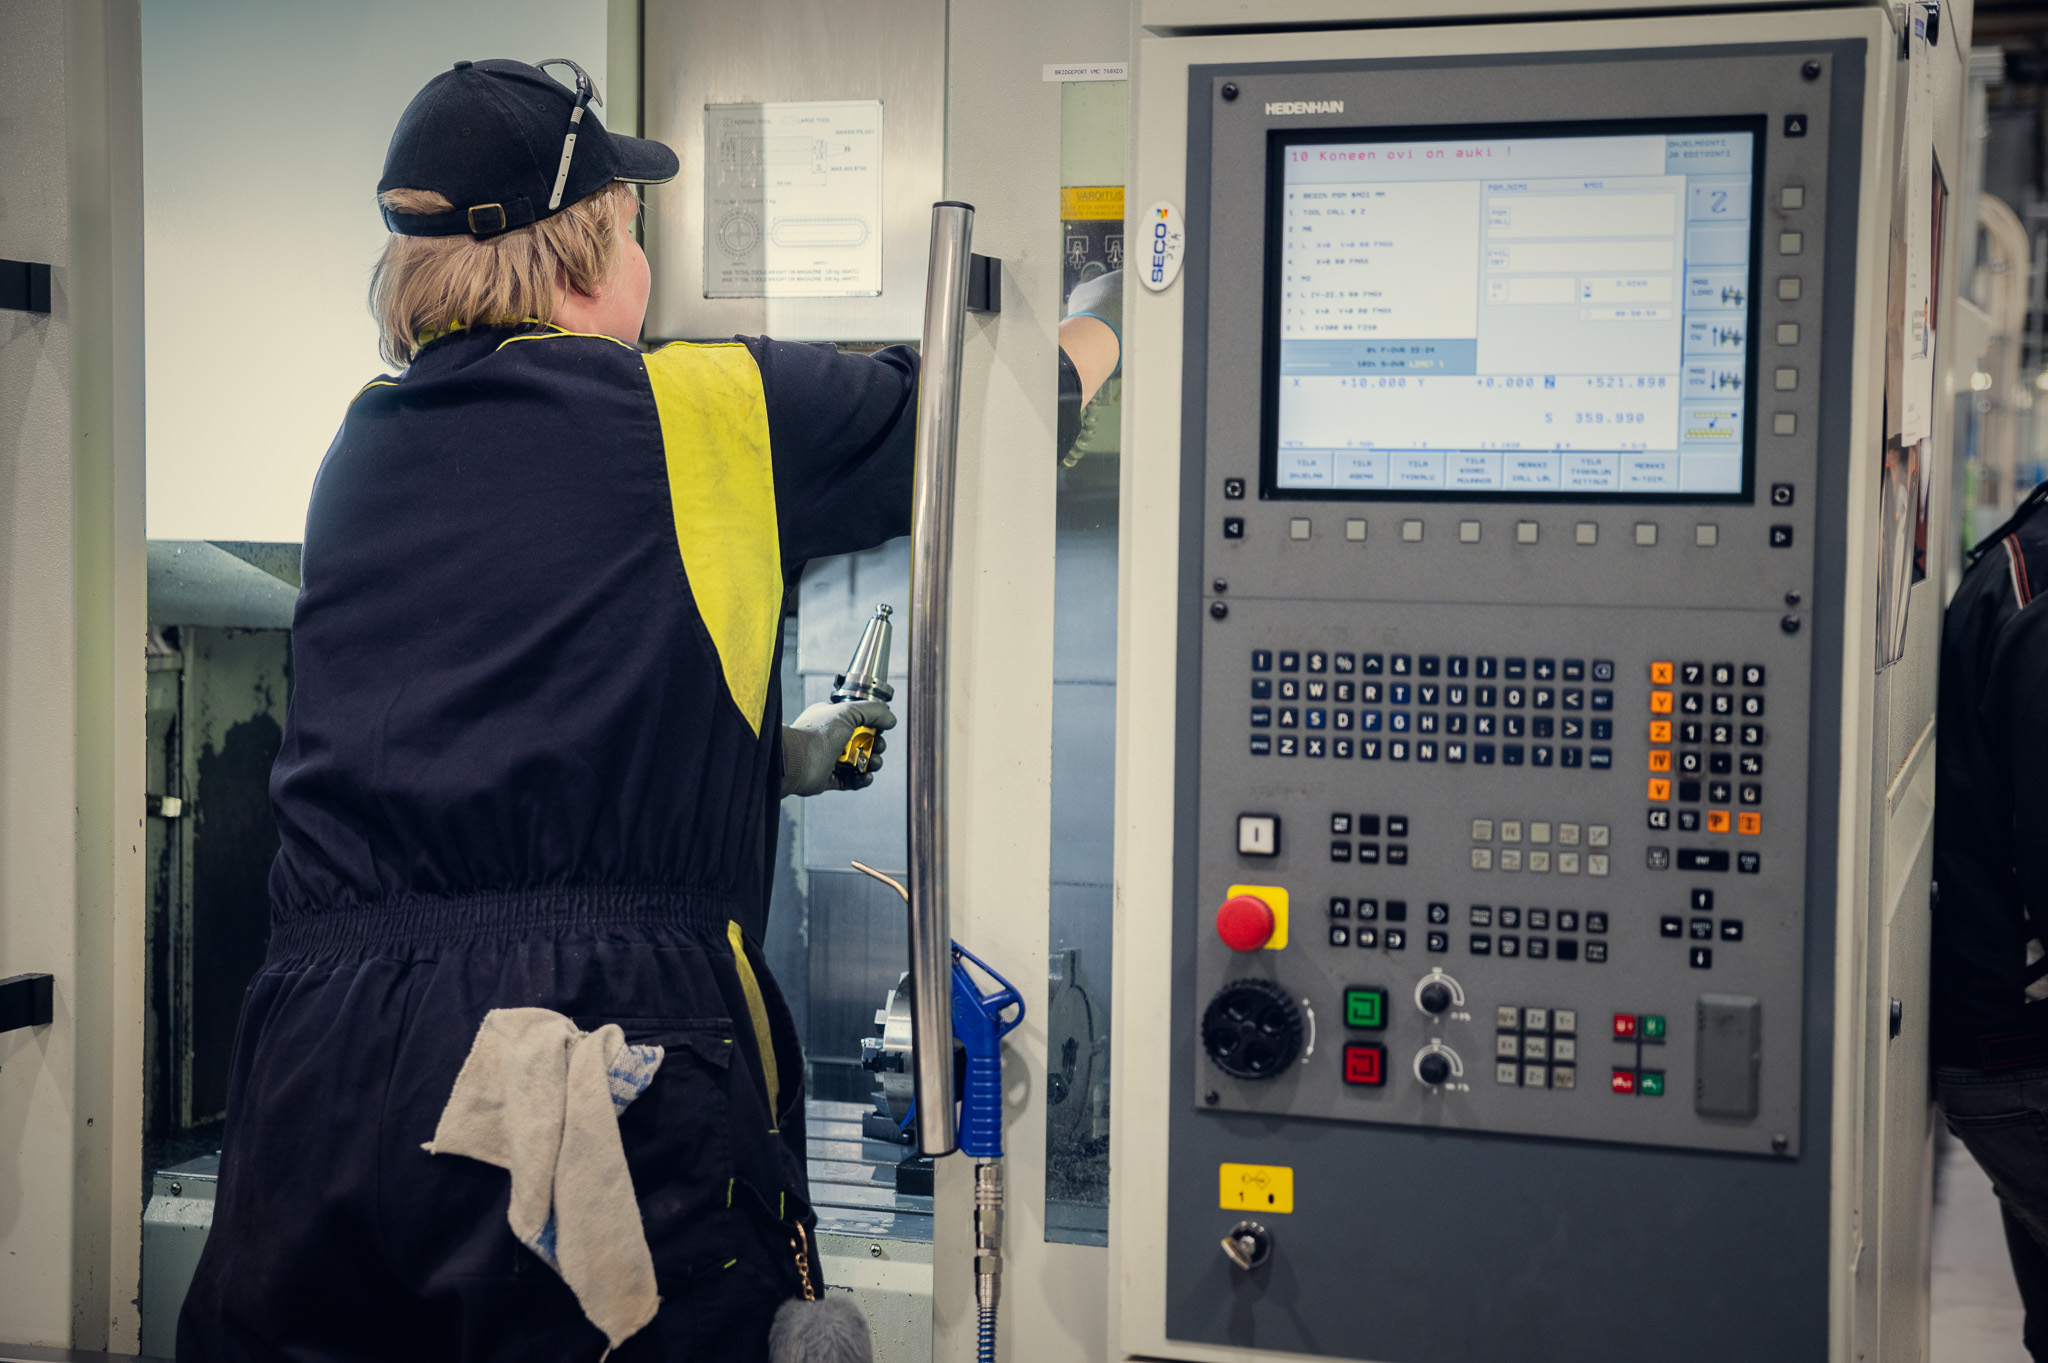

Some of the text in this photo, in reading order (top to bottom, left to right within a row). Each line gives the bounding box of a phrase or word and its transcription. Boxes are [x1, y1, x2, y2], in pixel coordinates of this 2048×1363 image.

[1265, 100, 1344, 115] HEIDENHAIN
[1292, 146, 1512, 162] 10 Koneen ovi on auki !
[1077, 191, 1124, 201] VAROITUS
[1152, 223, 1167, 283] SECO
[1293, 379, 1301, 388] X
[1341, 377, 1407, 388] +10.000
[1477, 377, 1535, 389] +0.000
[1587, 377, 1666, 388] +521.898
[1545, 412, 1646, 424] S 359.990
[1311, 654, 1321, 670] $
[1657, 666, 1759, 682] X 7 8 9
[1283, 682, 1293, 696] Q
[1309, 683, 1323, 696] W
[1338, 685, 1348, 699] E
[1365, 686, 1376, 699] R
[1396, 687, 1404, 700] T
[1422, 688, 1434, 701] Y
[1450, 689, 1461, 703] U
[1482, 689, 1488, 703] I
[1508, 690, 1519, 704] O
[1537, 691, 1548, 705] P
[1657, 696, 1757, 712] Y 4 5 6
[1282, 711, 1292, 723] A
[1310, 711, 1320, 725] S
[1337, 712, 1348, 727] D
[1365, 714, 1375, 727] F
[1393, 715, 1404, 729] G
[1422, 716, 1432, 729] H
[1452, 717, 1460, 731] J
[1479, 719, 1489, 732] K
[1508, 719, 1517, 733] L
[1655, 725, 1756, 742] Z 1 2 3
[1280, 739, 1293, 753] Z
[1309, 740, 1320, 754] X
[1337, 741, 1347, 755] C
[1365, 742, 1376, 756] V
[1393, 743, 1403, 757] B
[1421, 744, 1432, 758] N
[1448, 746, 1461, 758] M
[1683, 754, 1696, 769] 0
[1655, 785, 1664, 797] V
[1650, 811, 1666, 826] CE
[1711, 815, 1722, 827] P
